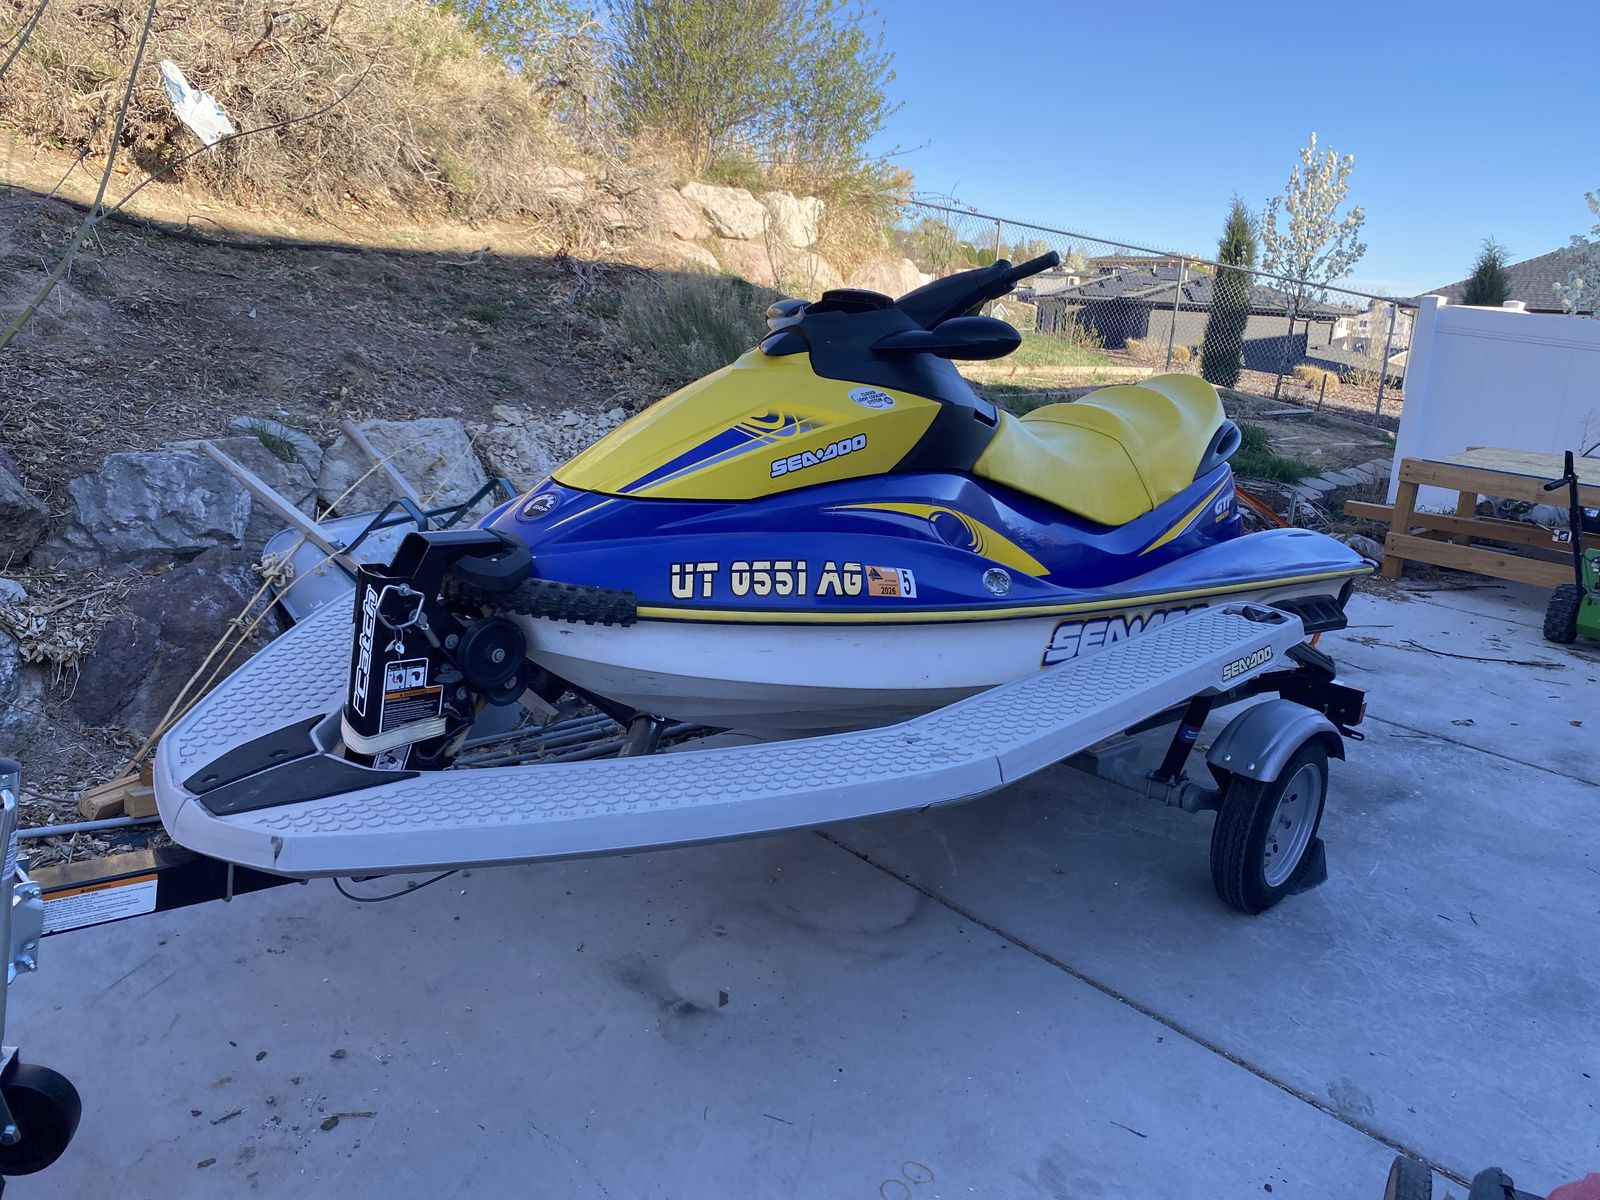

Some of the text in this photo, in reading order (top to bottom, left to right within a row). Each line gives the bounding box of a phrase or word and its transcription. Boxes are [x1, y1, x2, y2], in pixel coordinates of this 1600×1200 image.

[670, 560, 863, 598] UT 0551 AG
[880, 586, 897, 595] 2026
[901, 570, 912, 596] 5
